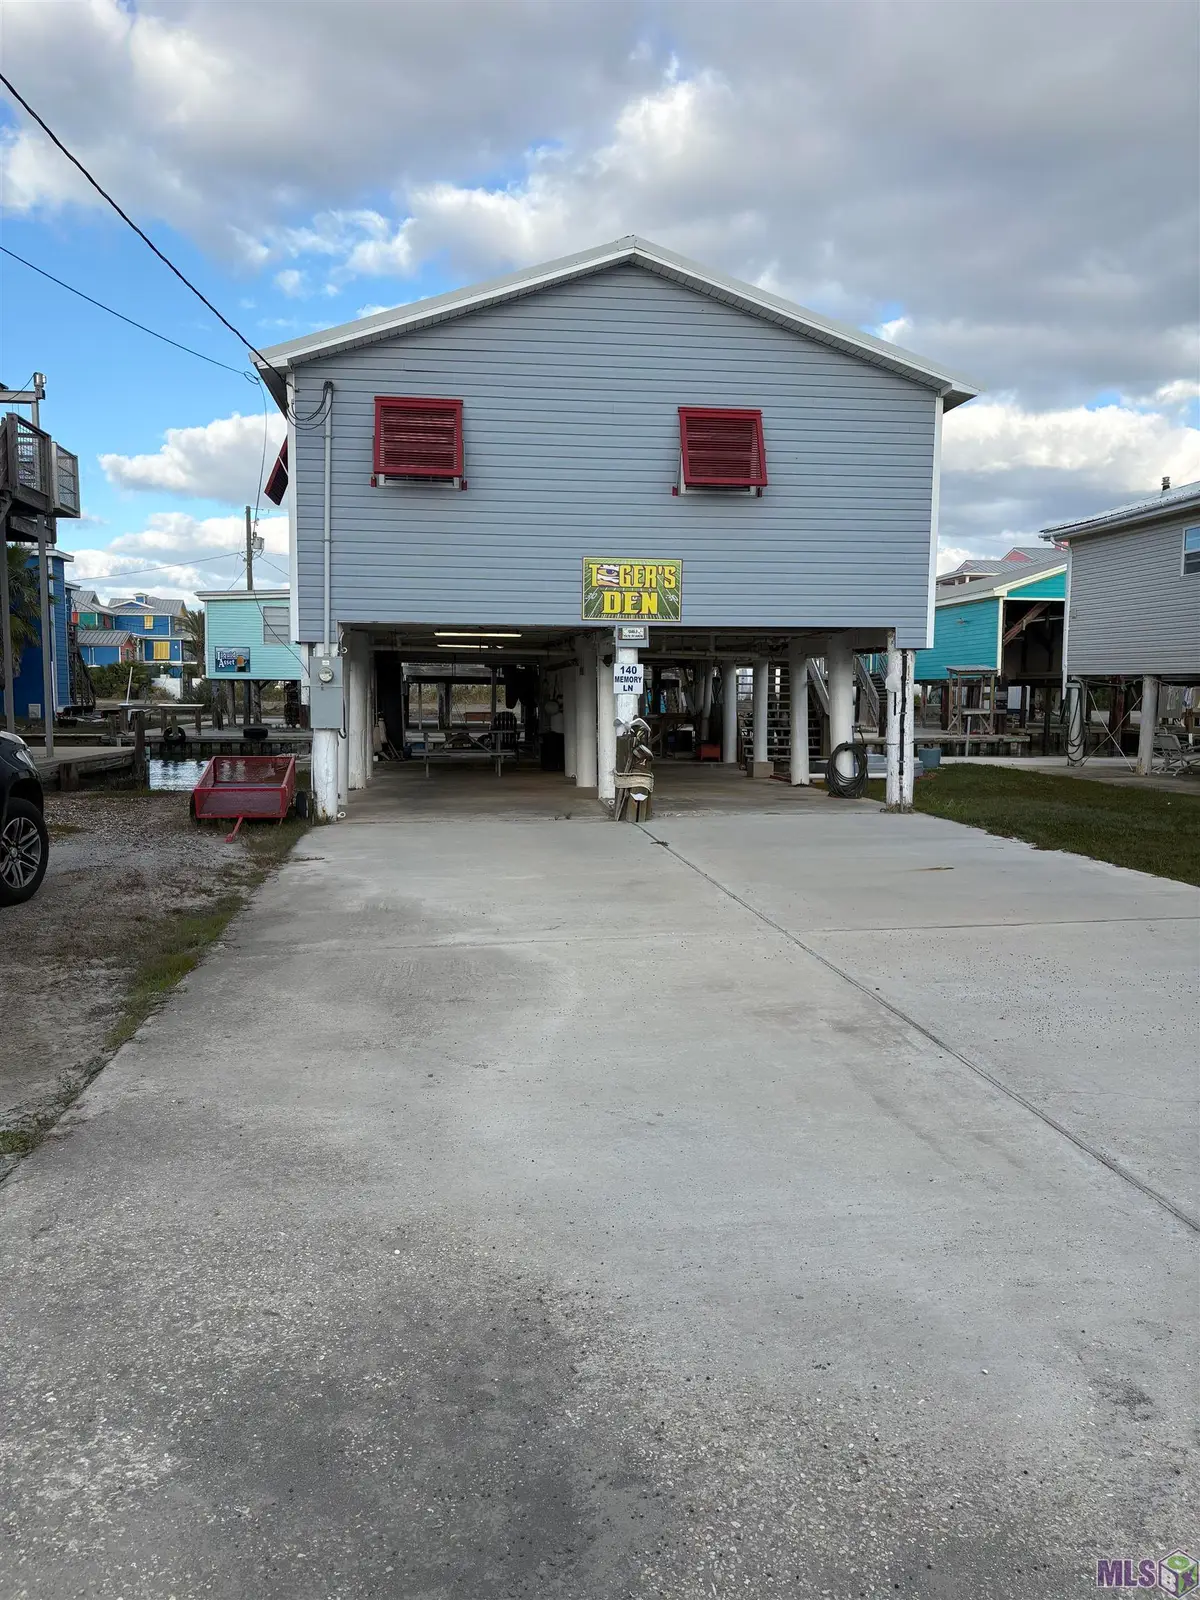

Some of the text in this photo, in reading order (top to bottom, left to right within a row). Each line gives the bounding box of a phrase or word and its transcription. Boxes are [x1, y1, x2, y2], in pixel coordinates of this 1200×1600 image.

[588, 564, 676, 589] TGER'S
[601, 591, 658, 614] DEN
[620, 666, 637, 674] 140
